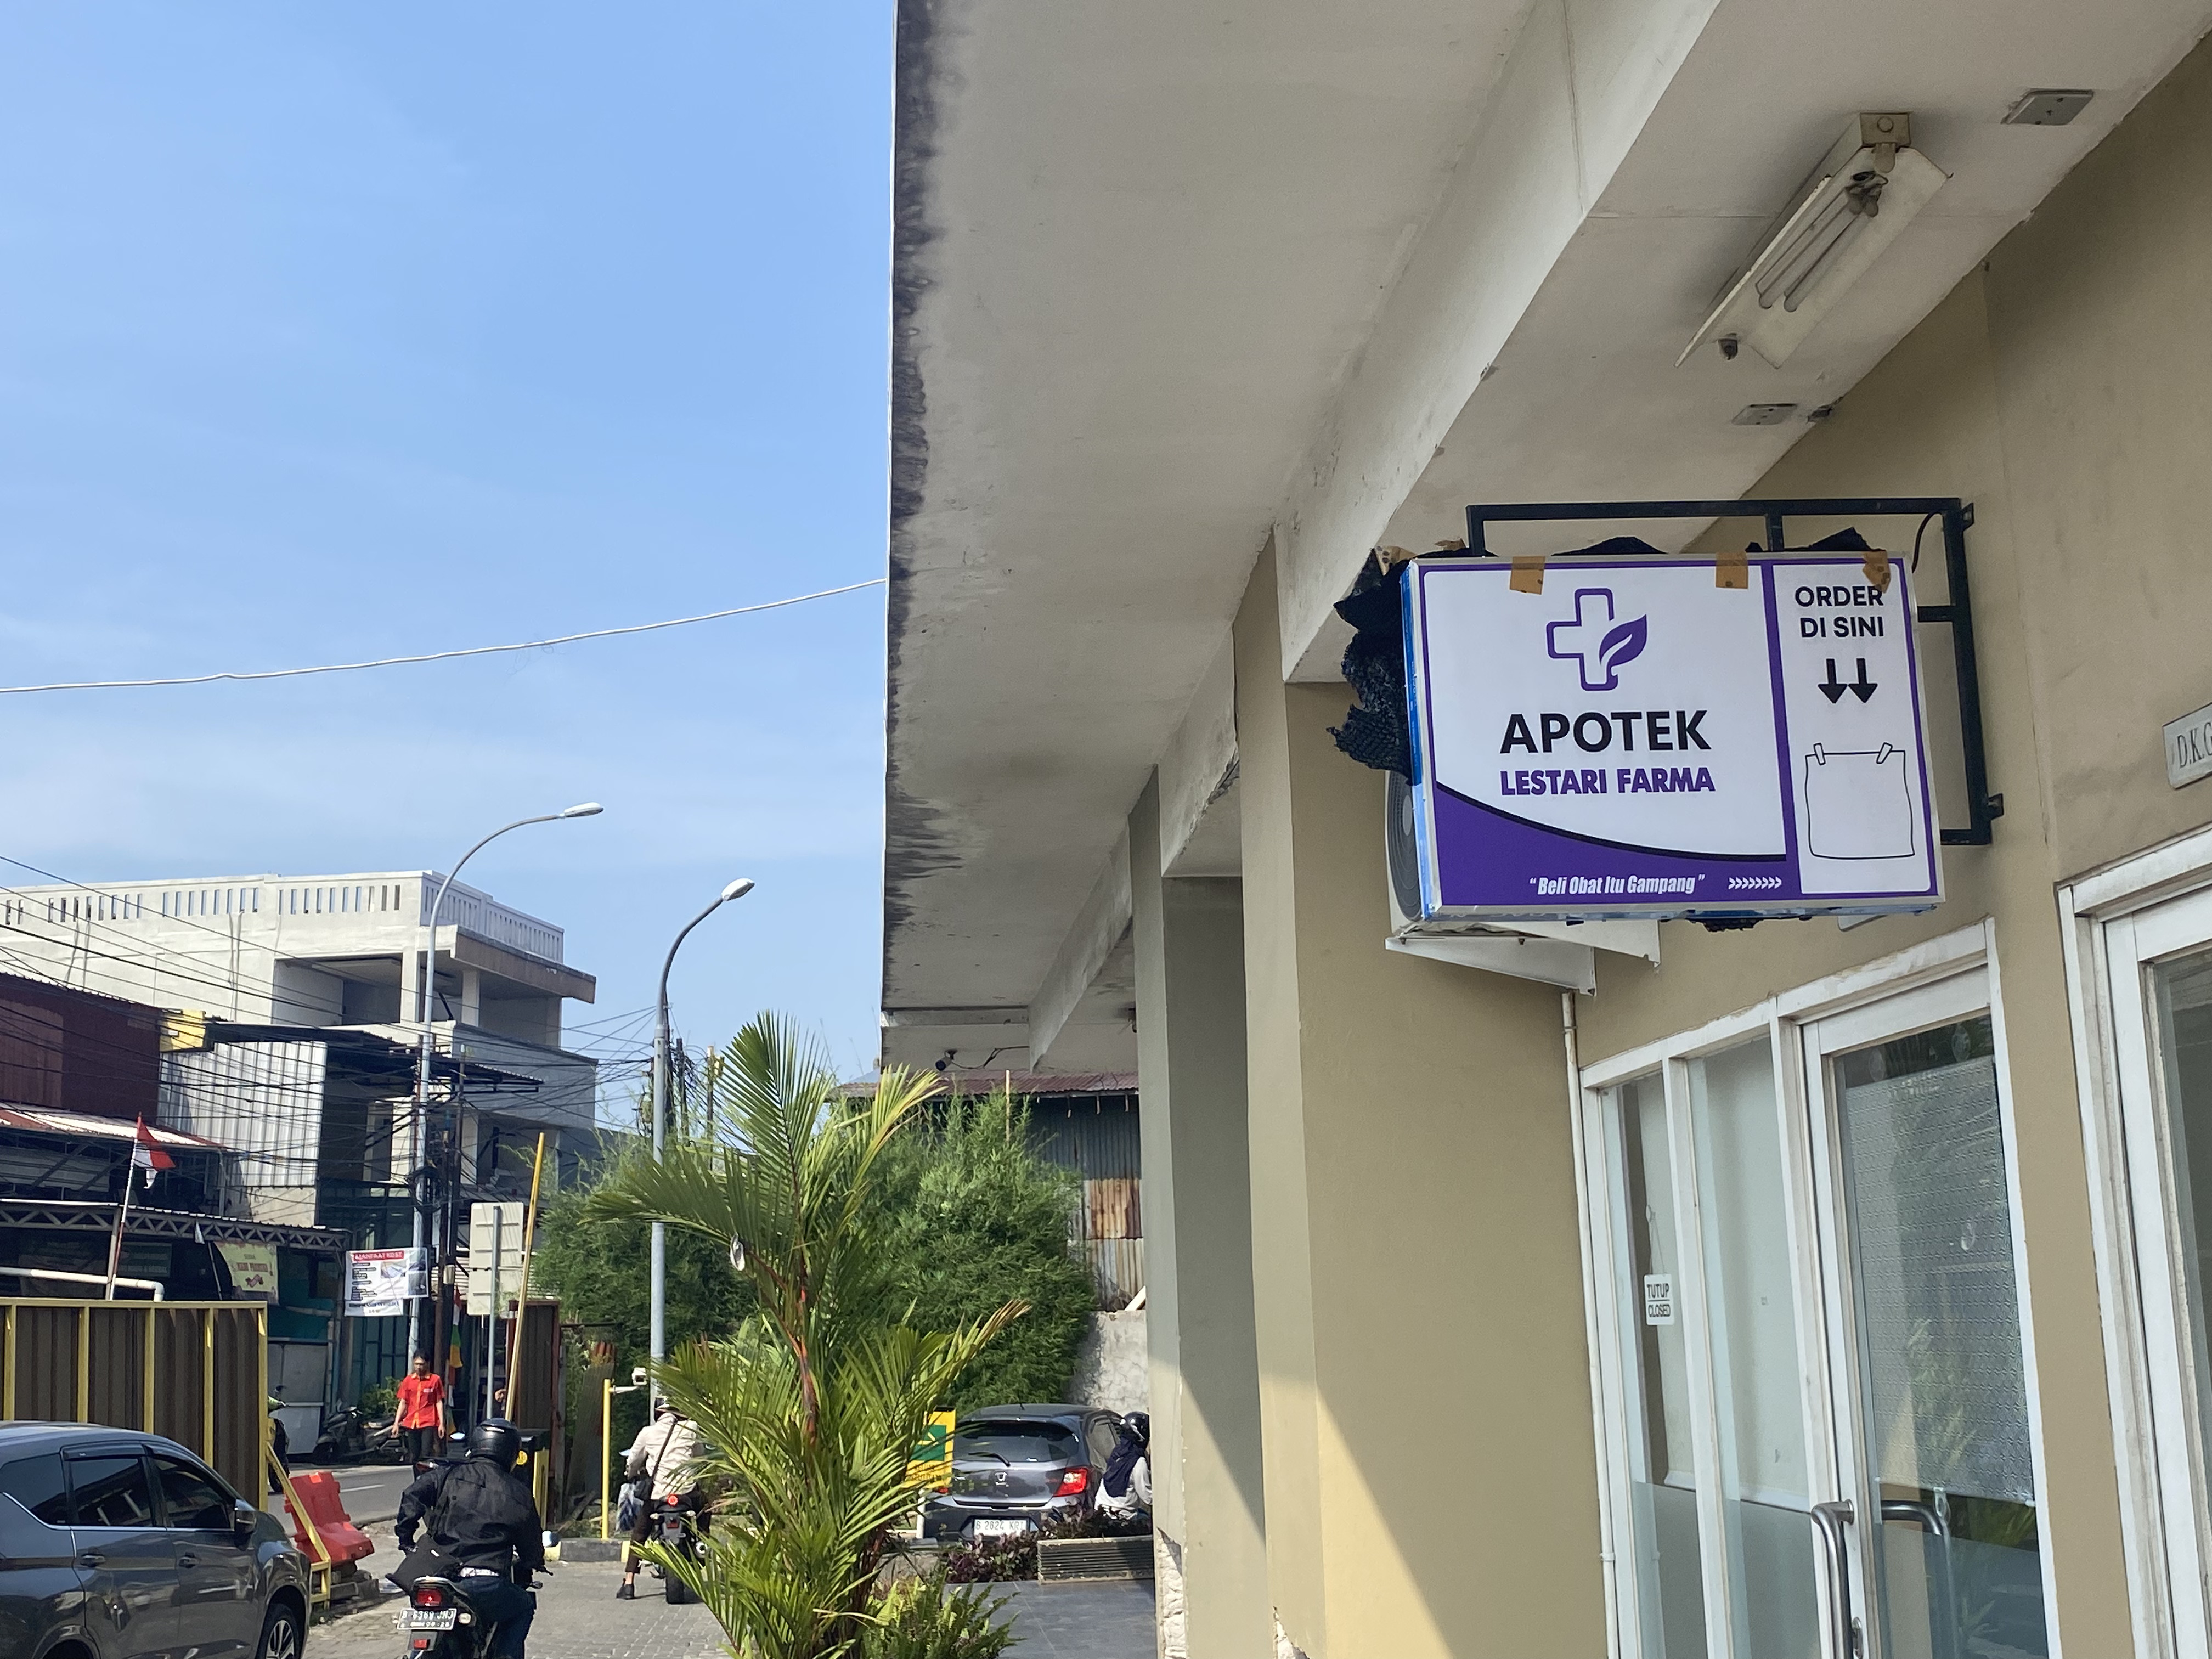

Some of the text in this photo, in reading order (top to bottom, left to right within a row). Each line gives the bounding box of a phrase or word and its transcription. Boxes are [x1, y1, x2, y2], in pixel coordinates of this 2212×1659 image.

[1795, 586, 1884, 607] ORDER
[1800, 616, 1884, 637] DI SINI
[1500, 710, 1712, 754] APOTEK
[1500, 767, 1716, 796] LESTARI FARMA
[1569, 876, 1602, 894] Obat
[1605, 876, 1625, 894] Itu
[1646, 1283, 1669, 1299] TUTUP
[1648, 1304, 1671, 1317] CLOSED
